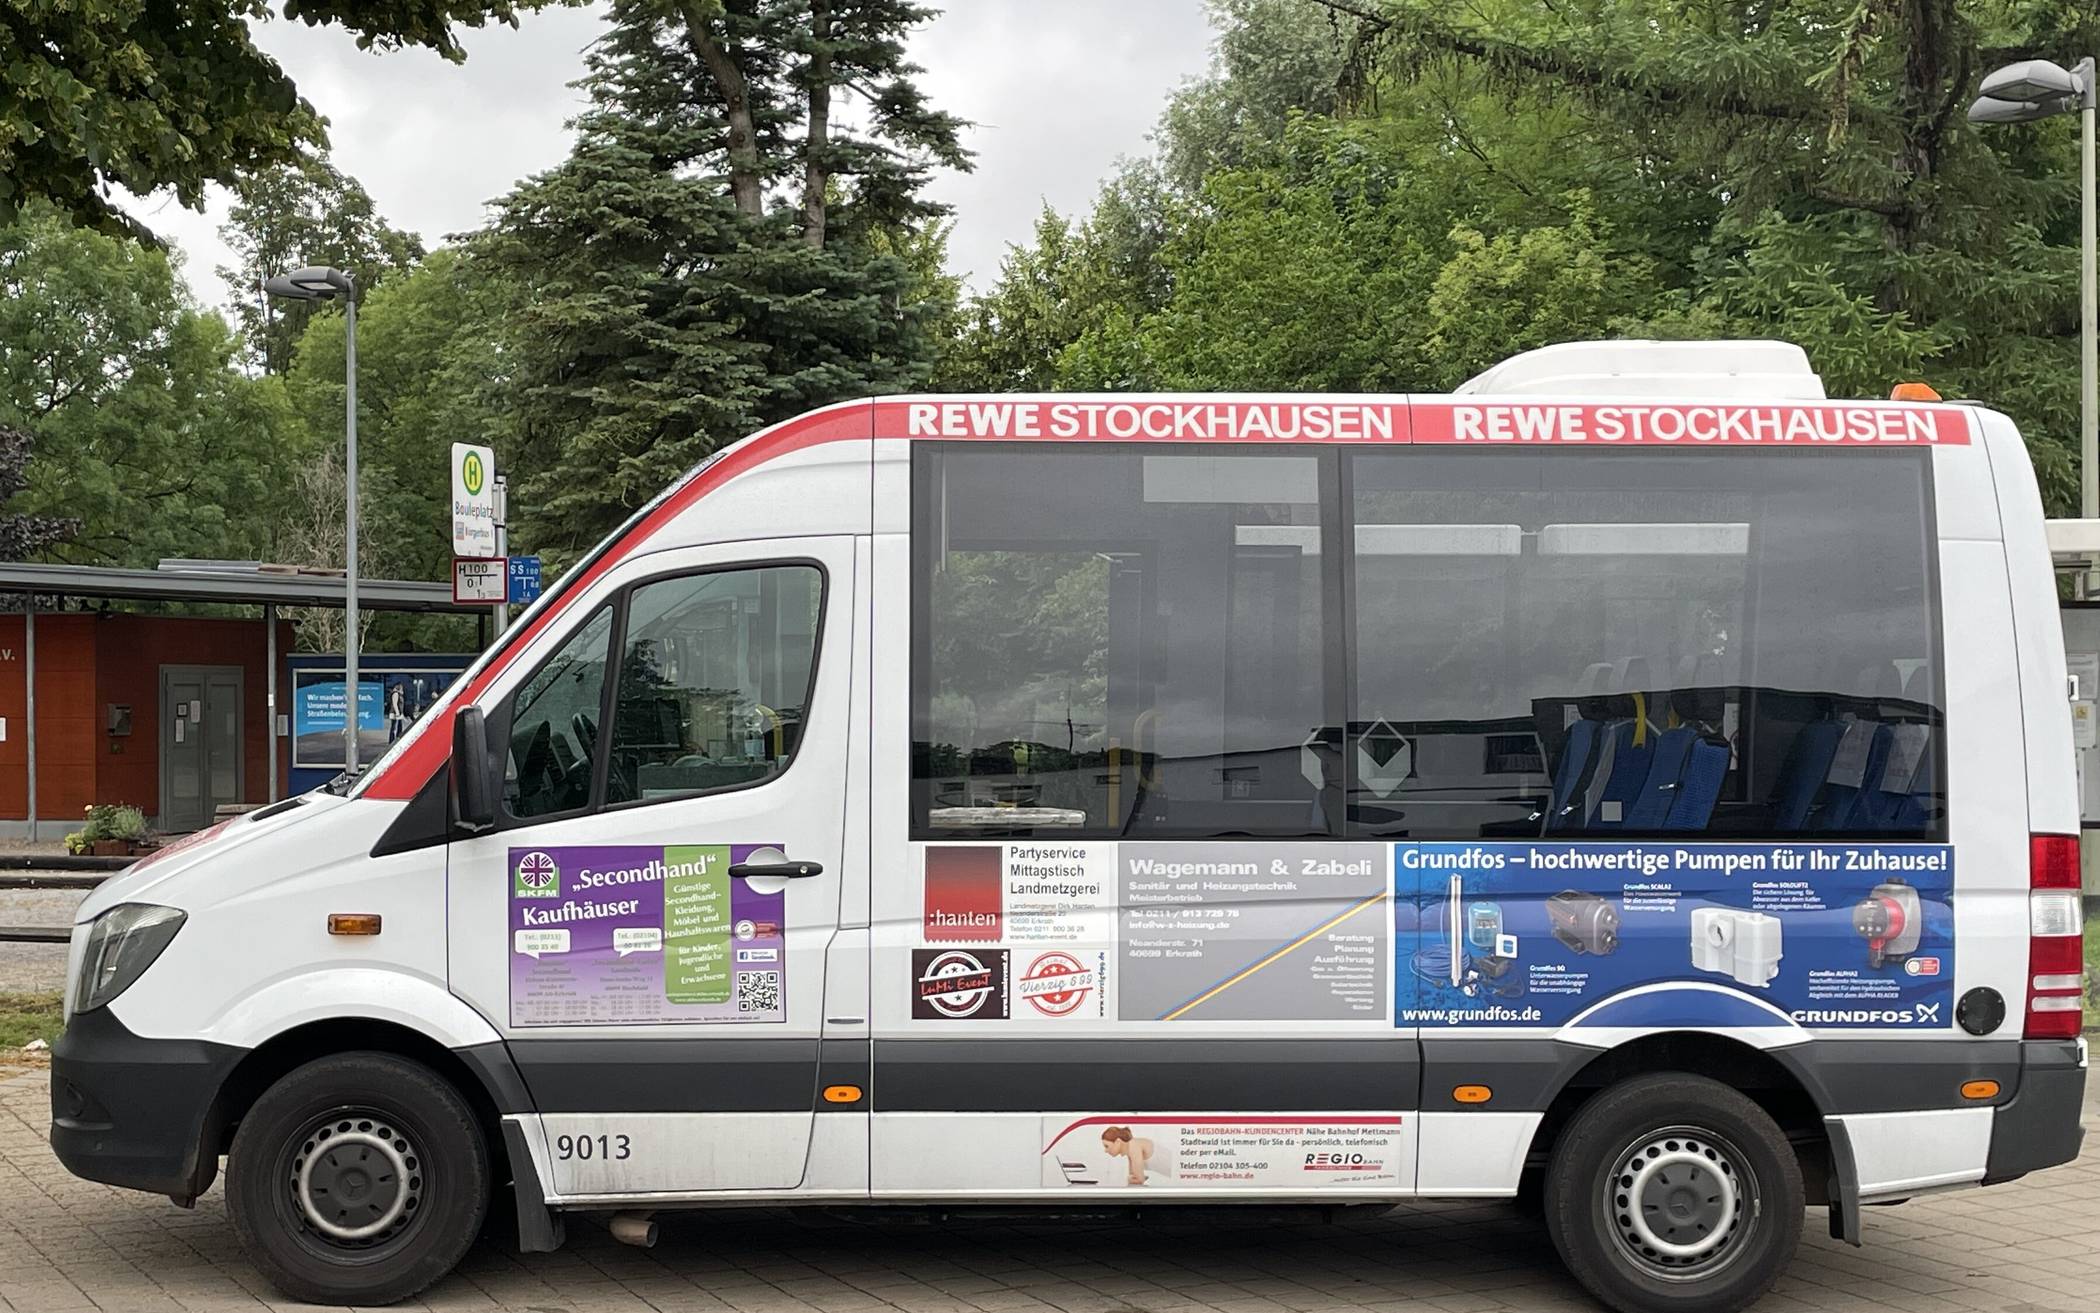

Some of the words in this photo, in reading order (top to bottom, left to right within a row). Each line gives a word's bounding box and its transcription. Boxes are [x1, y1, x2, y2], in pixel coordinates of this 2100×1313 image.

[908, 403, 1040, 437] REWE
[1050, 404, 1393, 439] STOCKHAUSEN
[1453, 406, 1586, 440] REWE
[1595, 408, 1939, 442] STOCKHAUSEN
[468, 461, 477, 486] H
[455, 501, 494, 519] Bouleplatz
[1010, 846, 1086, 860] Partyservice
[1403, 849, 1505, 869] Grundfos
[1530, 849, 1669, 875] hochwertige
[1675, 850, 1766, 875] Pumpen
[1772, 849, 1804, 870] für
[1810, 850, 1840, 870] Ihr
[1846, 850, 1947, 870] Zuhause!
[1010, 864, 1084, 879] Mittagstisch
[1129, 859, 1258, 878] Wagemann
[1270, 859, 1289, 876] &
[1301, 859, 1372, 876] Zabeli
[674, 882, 711, 893] Günstige
[1010, 882, 1100, 898] Landmetzgerei
[1129, 881, 1170, 890] Sanitär
[1176, 881, 1198, 890] und
[1203, 881, 1297, 892] Heizungstechnik
[517, 889, 557, 897] SKFM
[666, 893, 721, 905] Secondhand-
[1129, 894, 1203, 902] Meisterbetrieb
[523, 900, 640, 926] Kaufhäuser
[929, 909, 997, 927] :hanten
[673, 915, 700, 926] Möbel
[703, 913, 719, 922] und
[664, 924, 731, 938] Haushaltswaren
[1328, 934, 1374, 943] Beratung
[1334, 945, 1374, 954] Planung
[679, 953, 723, 965] Jugendliche
[1314, 955, 1374, 964] Ausführung
[694, 964, 710, 972] und
[681, 973, 726, 984] Erwachsene
[1019, 977, 1066, 994] Vierzig
[1403, 1006, 1541, 1024] www.grundfos.de
[1790, 1010, 1913, 1023] GRUNDFOS
[1306, 1127, 1324, 1135] Nähe
[1327, 1127, 1359, 1135] Bahnhof
[557, 1134, 631, 1160] 9013
[1180, 1138, 1219, 1146] Stadtwald
[1221, 1138, 1230, 1146] ist
[1232, 1138, 1256, 1146] immer
[1258, 1138, 1271, 1146] für
[1272, 1138, 1283, 1146] Sie
[1285, 1138, 1294, 1146] da
[1302, 1138, 1343, 1148] persönlich,
[1345, 1138, 1388, 1146] telefonisch
[1180, 1148, 1198, 1156] oder
[1200, 1149, 1211, 1158] per
[1213, 1148, 1237, 1156] eMail.
[1305, 1153, 1363, 1164] REGIO
[1180, 1162, 1208, 1170] Telefon
[1209, 1162, 1233, 1170] 02104
[1235, 1162, 1268, 1170] 305-400
[1179, 1173, 1254, 1181] www.regio-bahn.de
